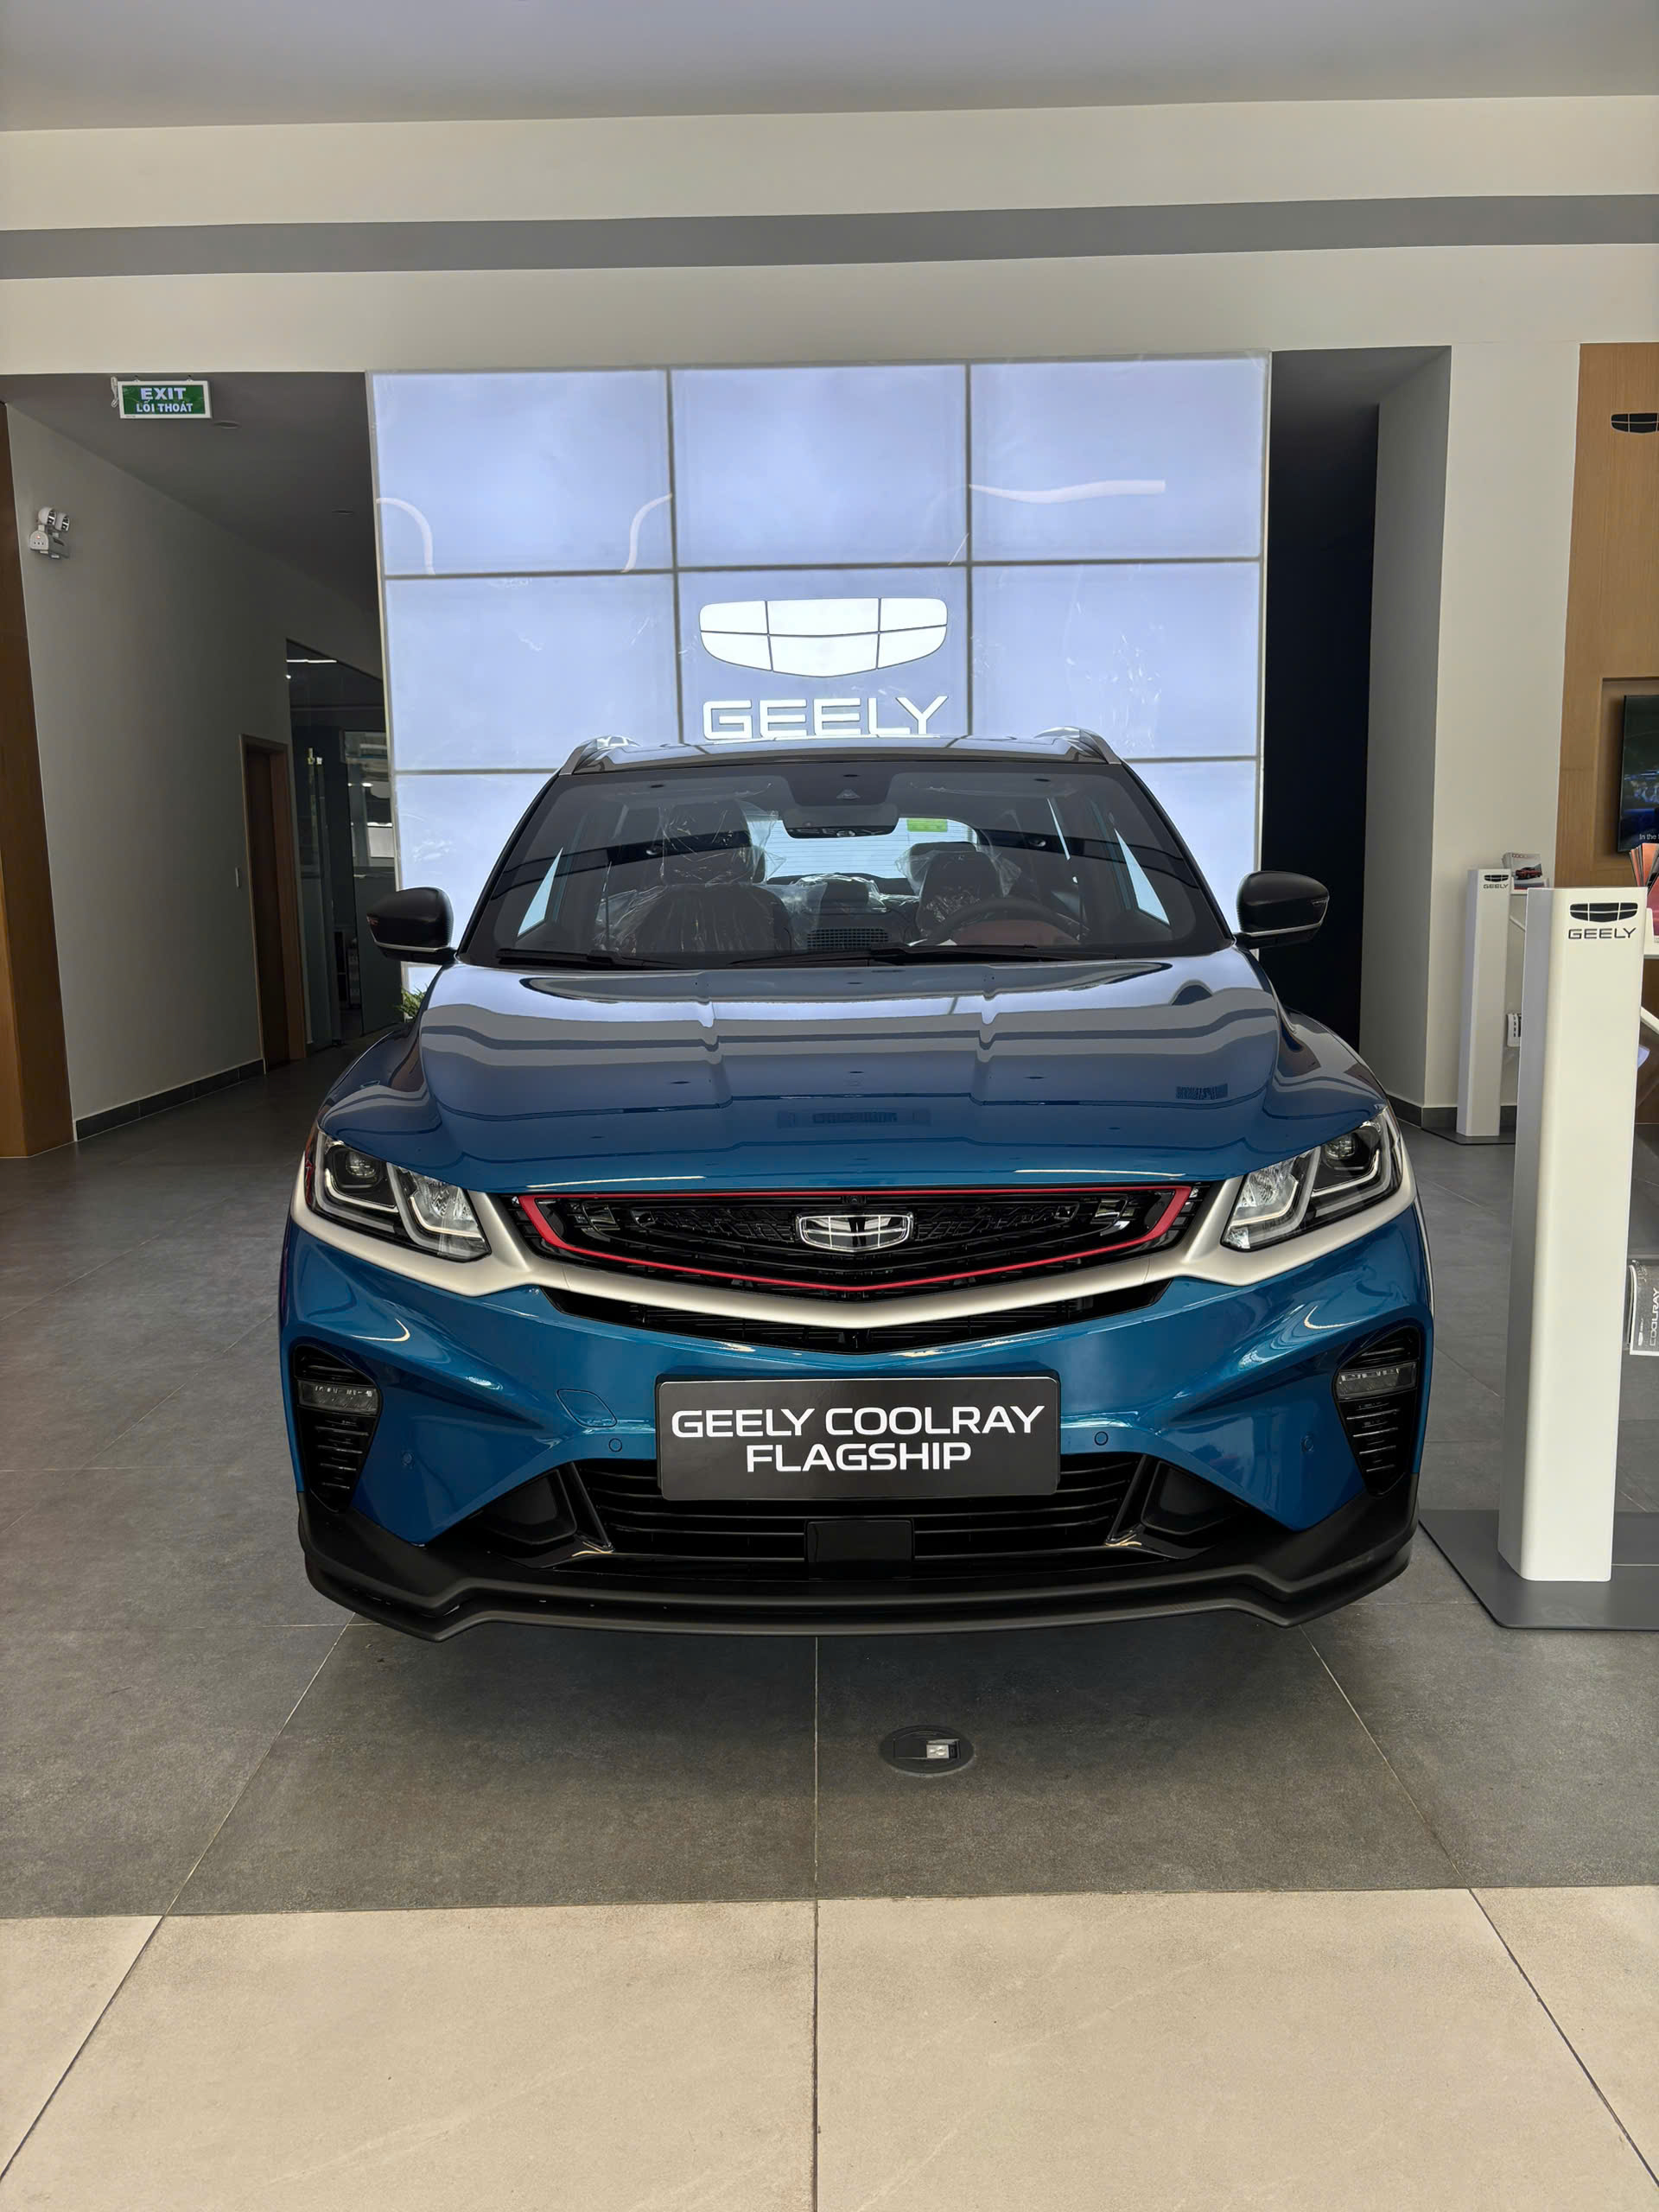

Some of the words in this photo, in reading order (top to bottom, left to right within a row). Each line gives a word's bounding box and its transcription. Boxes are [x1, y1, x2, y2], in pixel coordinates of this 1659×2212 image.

[140, 387, 187, 400] EXIT
[157, 401, 194, 412] THOÁT
[702, 696, 949, 740] GEELY
[1568, 927, 1637, 939] GEELY
[671, 1408, 815, 1438] GEELY
[825, 1405, 1045, 1436] COOLRAY
[747, 1441, 972, 1472] FLAGSHIP
